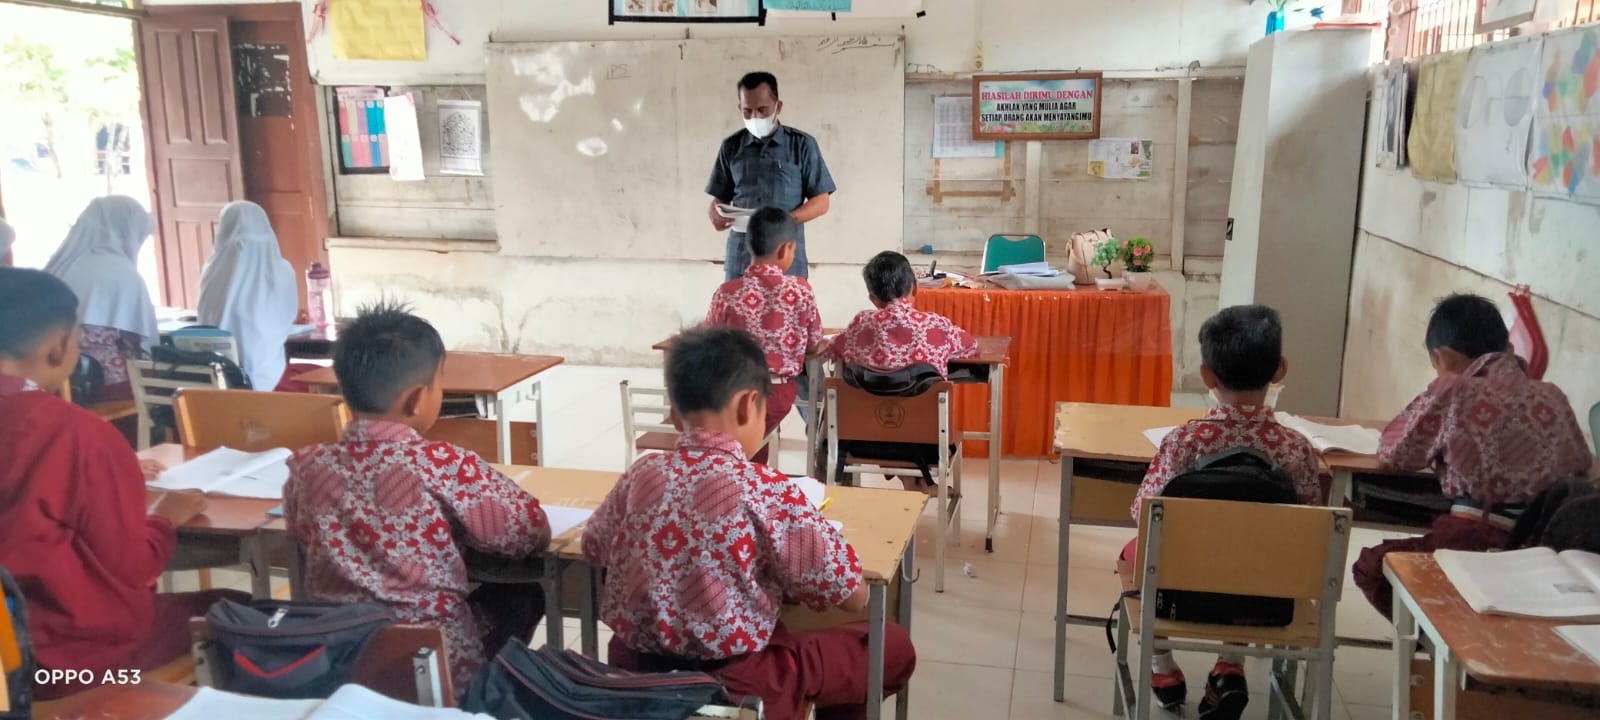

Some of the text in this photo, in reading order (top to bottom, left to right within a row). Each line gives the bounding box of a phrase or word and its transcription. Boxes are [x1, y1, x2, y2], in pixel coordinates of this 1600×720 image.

[981, 90, 1093, 102] HIASILAH DIRIMU DENGAN
[997, 102, 1077, 111] AKHLAK YANG MULIA AGAR
[981, 111, 1092, 122] SETIAP ORANG AKAN MENYAYANGIMU
